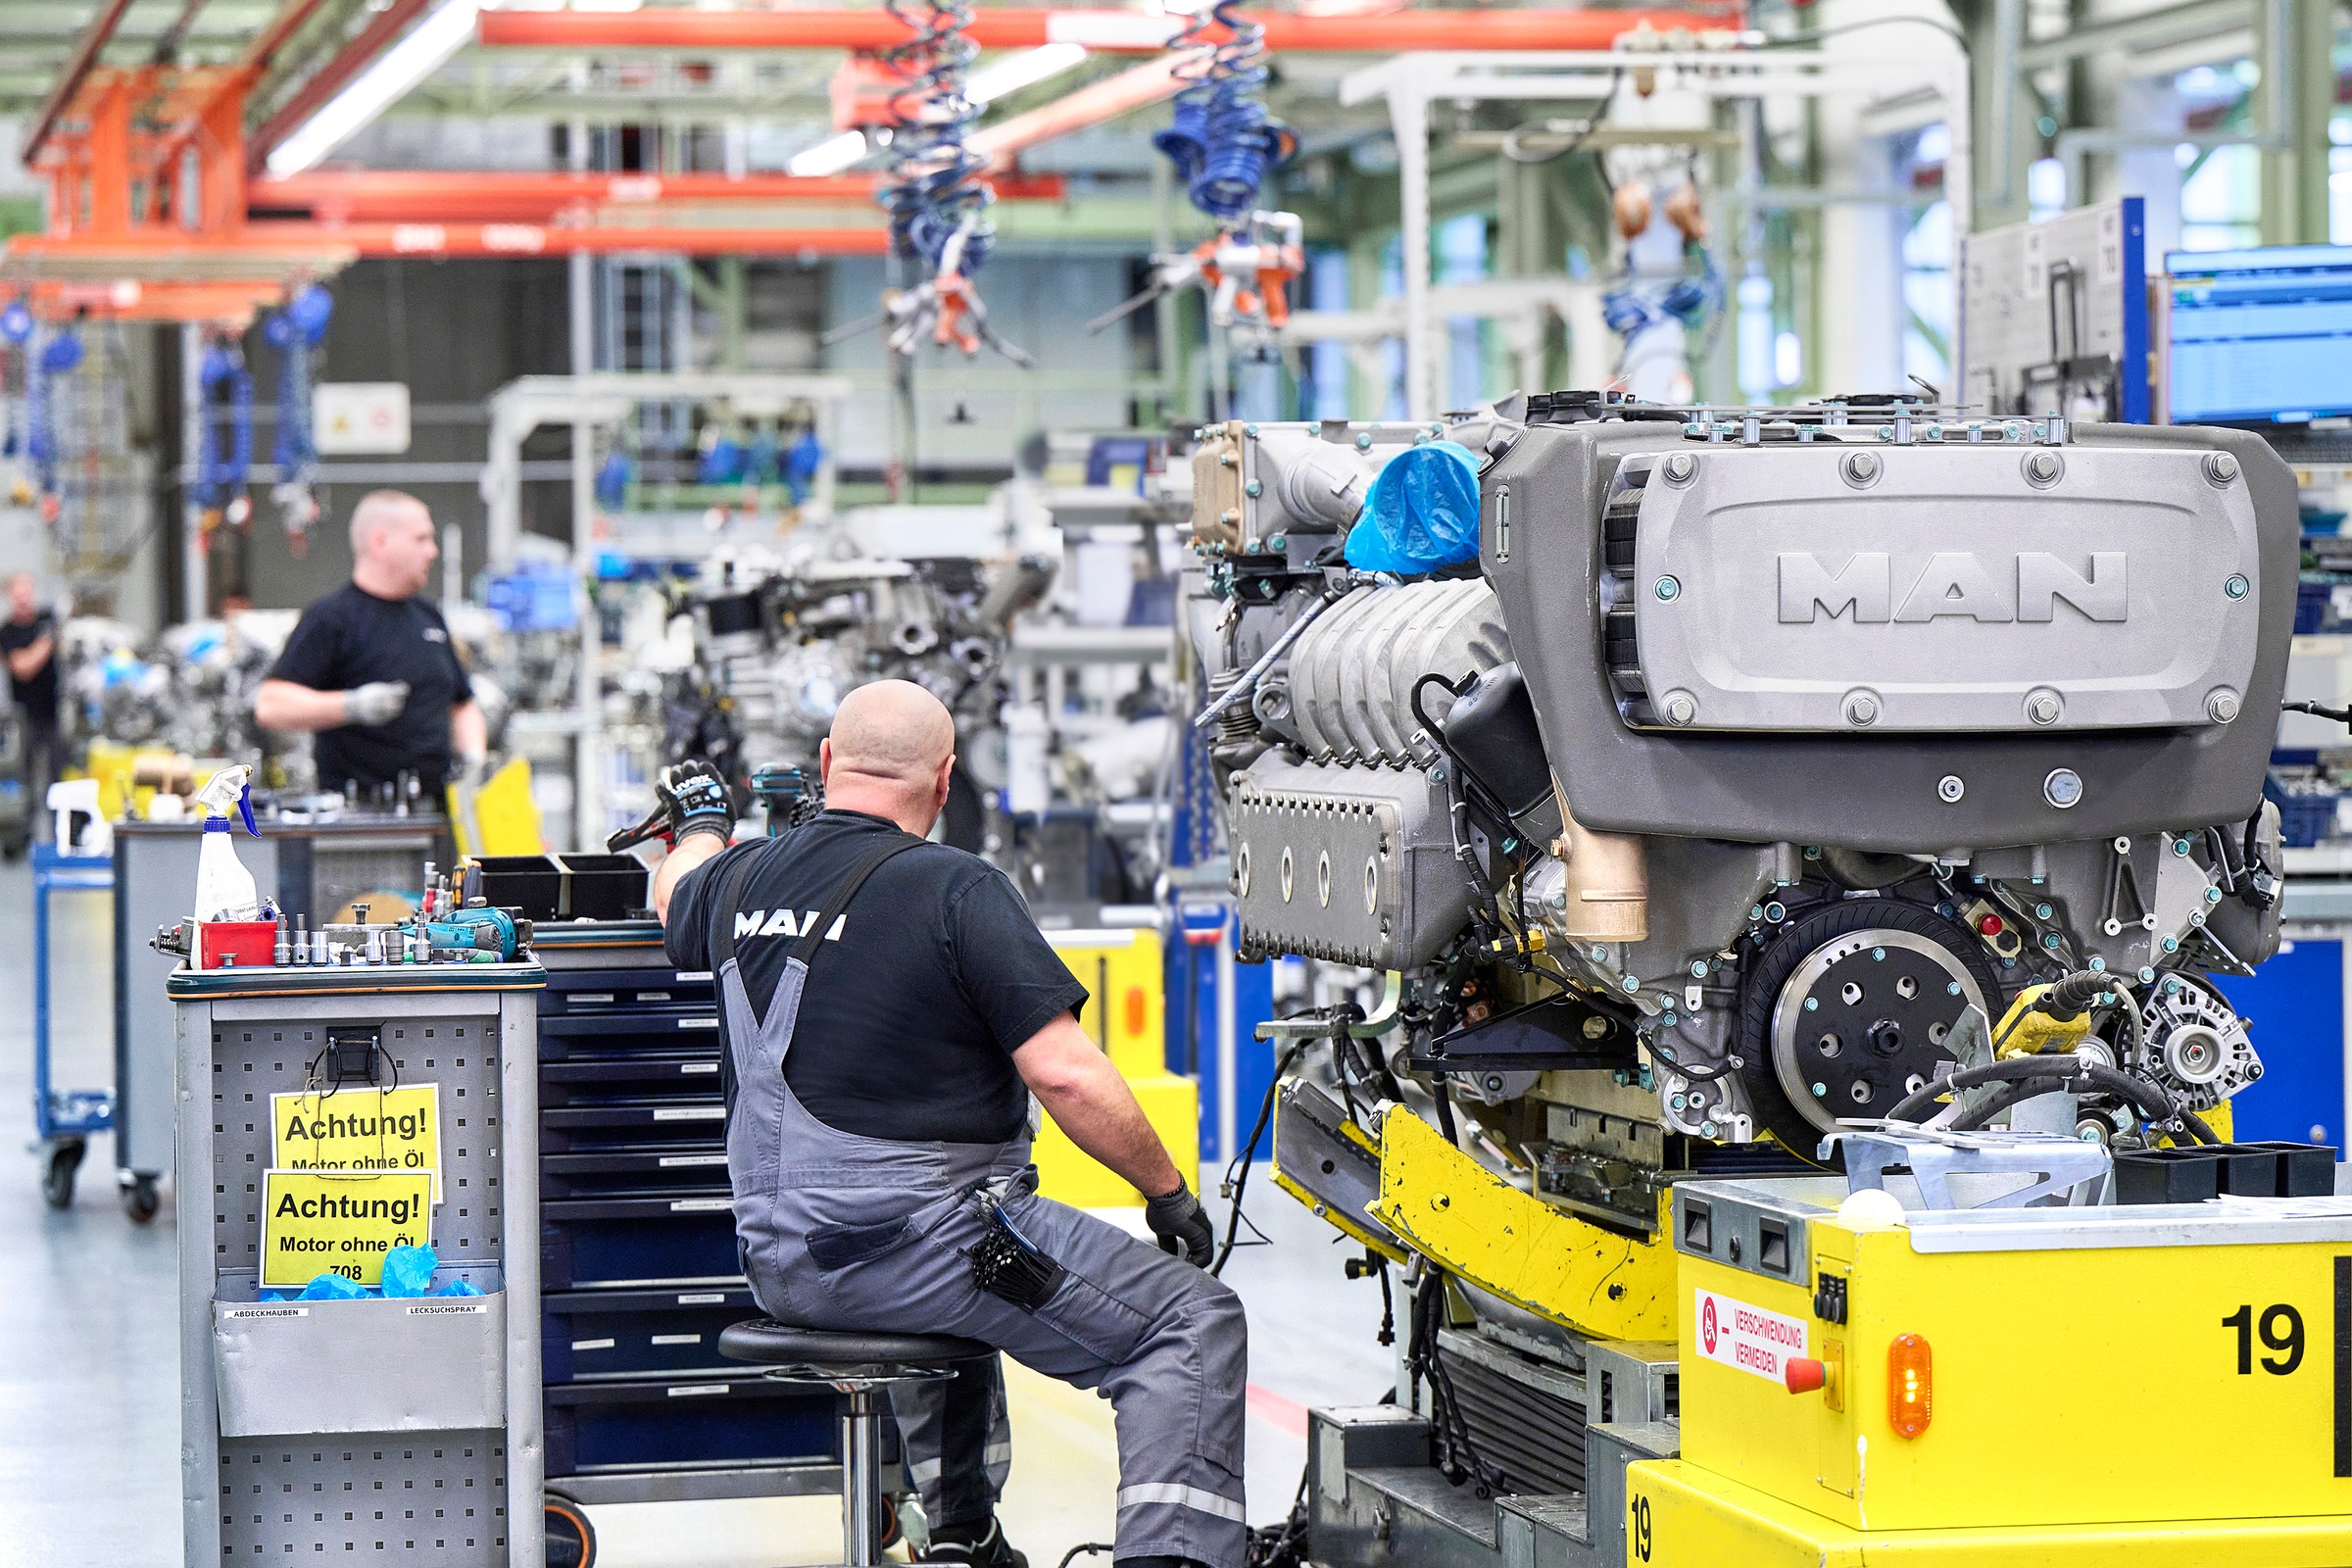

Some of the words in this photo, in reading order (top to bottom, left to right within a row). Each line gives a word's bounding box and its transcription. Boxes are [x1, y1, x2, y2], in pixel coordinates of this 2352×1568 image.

[1777, 552, 2129, 623] MAN
[284, 1107, 426, 1141] Achtung!
[352, 1155, 399, 1170] ohne
[404, 1150, 424, 1168] Öl
[275, 1193, 419, 1225] Achtung!
[279, 1236, 335, 1252] Motor
[340, 1236, 388, 1252] ohne
[329, 1265, 363, 1281] 708
[233, 1308, 299, 1318] ABDECKHAUBEN
[410, 1305, 477, 1315] LECKSUCHSPRAY
[1734, 1308, 1802, 1348] VERSCHWENDUNG
[2222, 1303, 2305, 1376] 19
[1734, 1341, 1778, 1375] VERMEIDEN
[1632, 1494, 1651, 1563] 19
